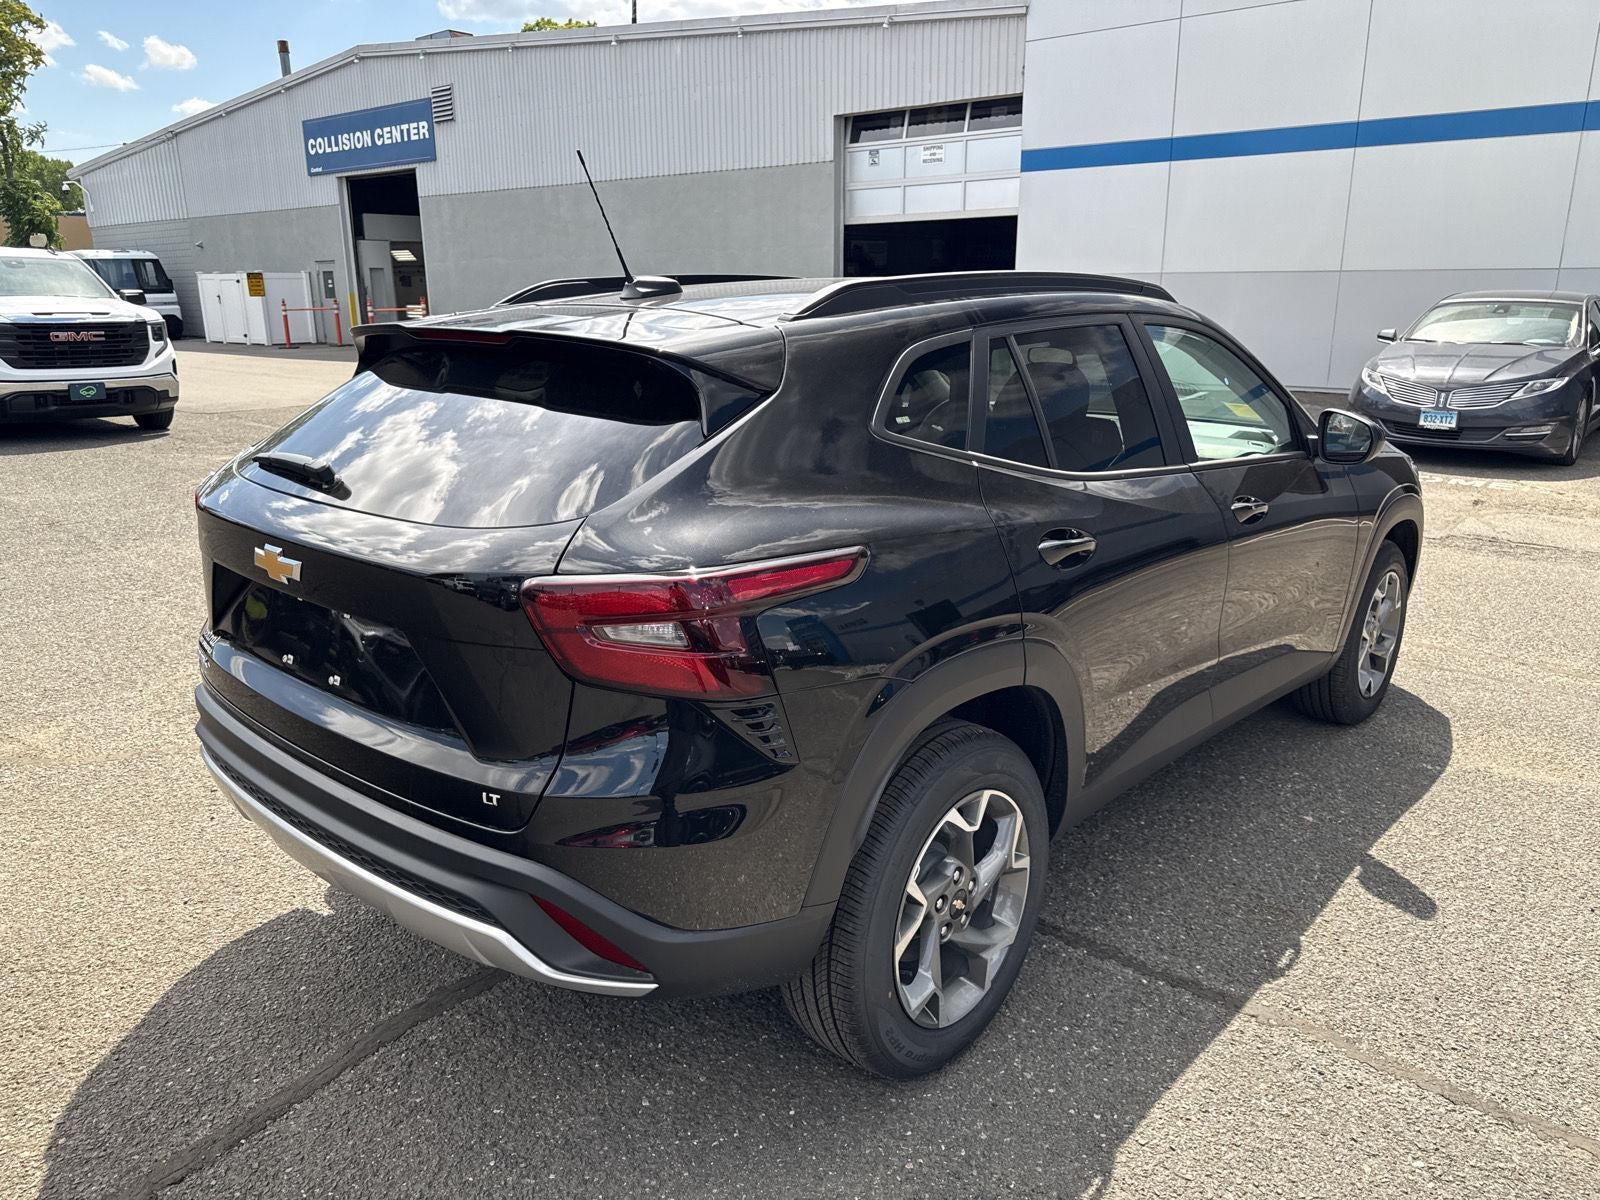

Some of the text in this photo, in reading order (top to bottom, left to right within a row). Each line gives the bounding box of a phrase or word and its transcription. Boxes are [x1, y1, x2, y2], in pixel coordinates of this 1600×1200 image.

[308, 121, 430, 155] COLLISION CENTER
[49, 331, 106, 342] GMC
[482, 792, 501, 807] LT
